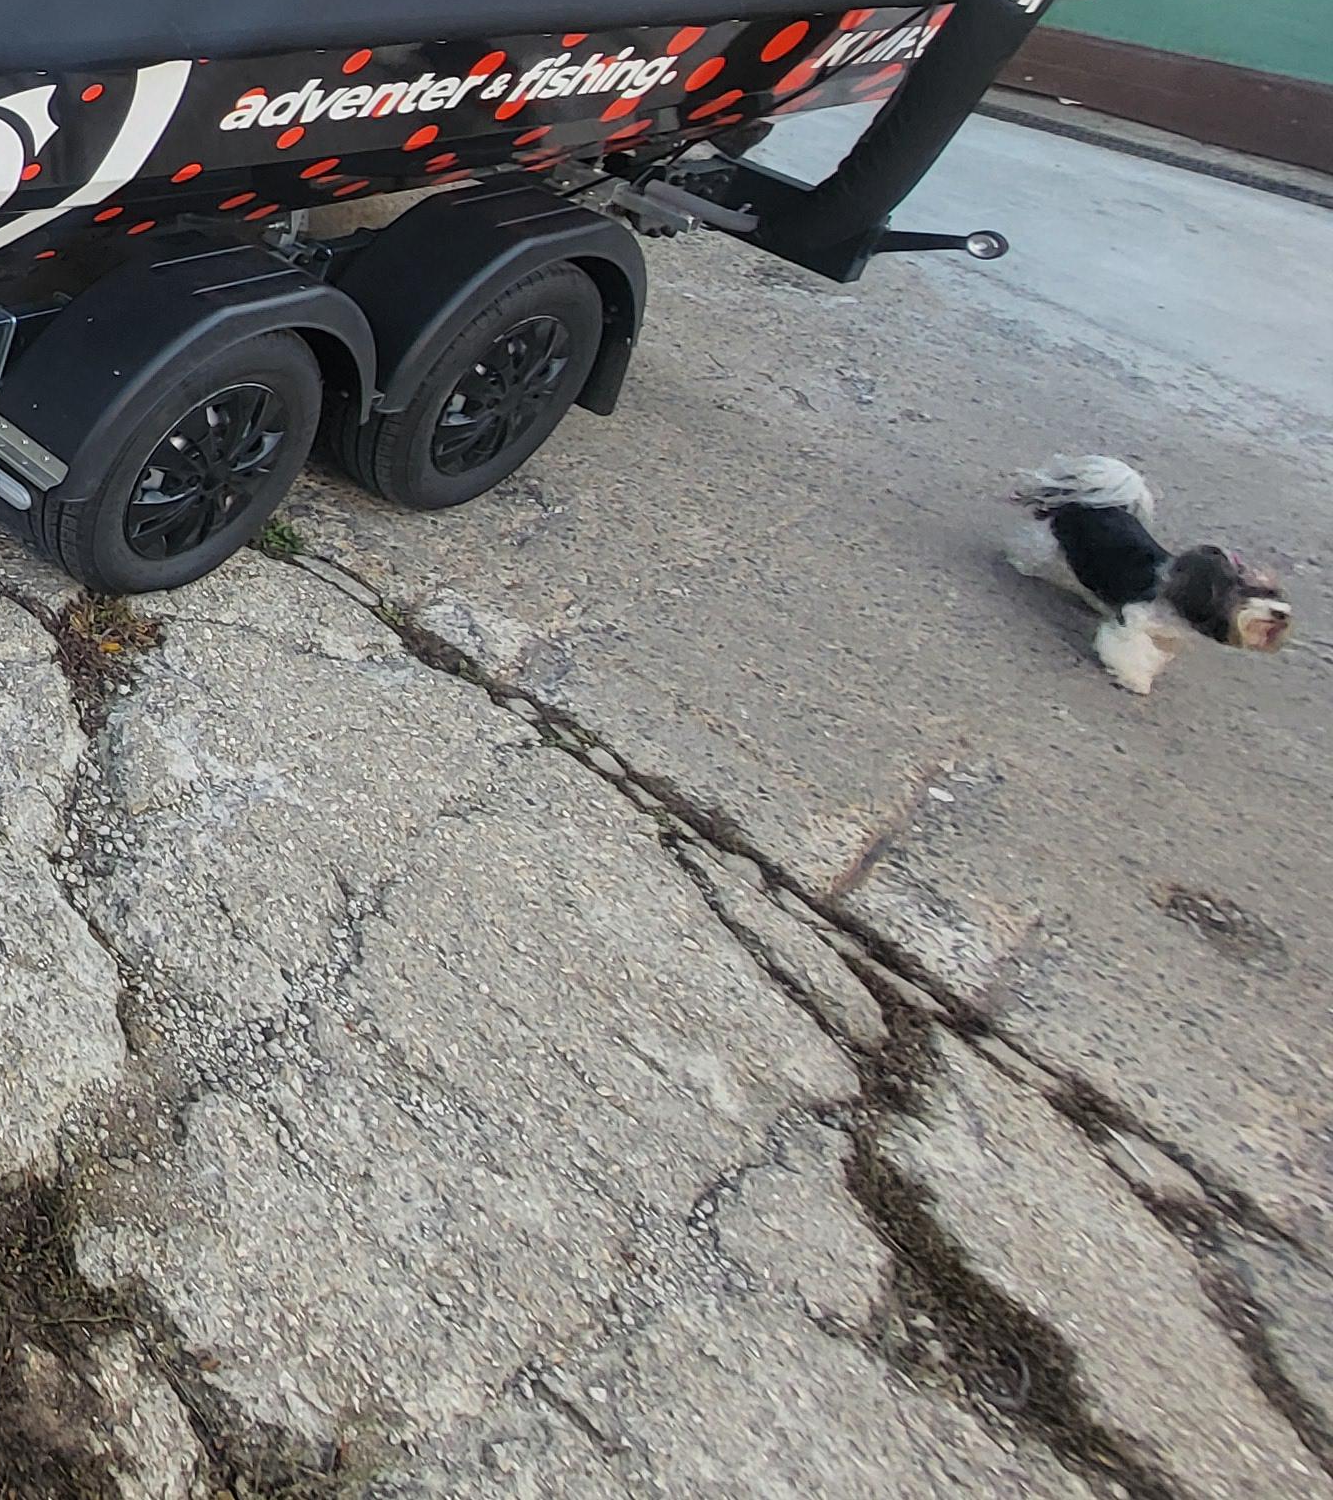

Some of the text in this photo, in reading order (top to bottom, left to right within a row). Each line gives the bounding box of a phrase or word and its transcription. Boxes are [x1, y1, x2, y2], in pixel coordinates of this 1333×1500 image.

[219, 46, 679, 131] adventer & fishing.
